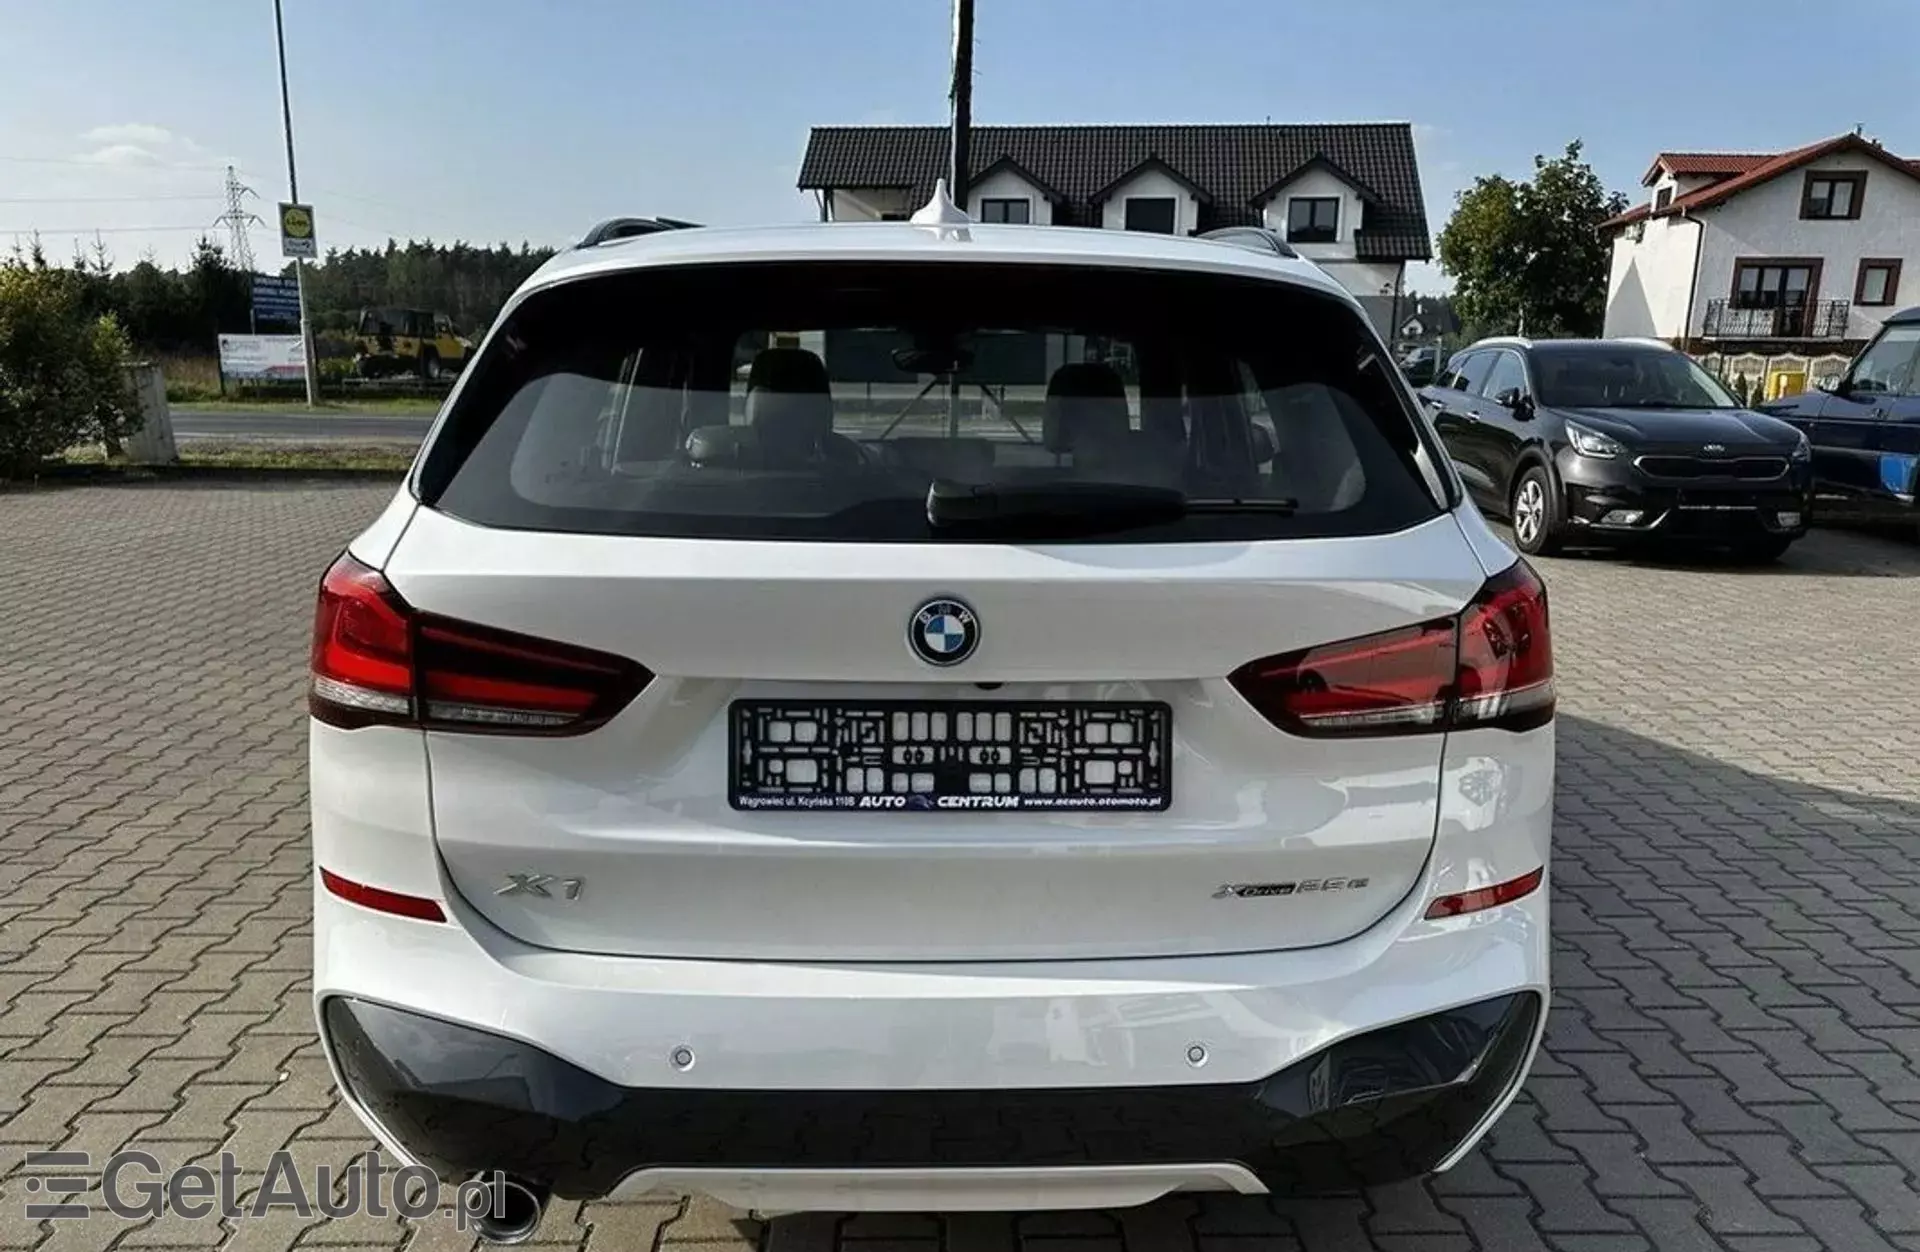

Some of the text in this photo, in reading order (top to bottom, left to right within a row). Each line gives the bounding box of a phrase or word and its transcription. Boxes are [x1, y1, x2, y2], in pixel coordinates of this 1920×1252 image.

[859, 796, 907, 808] AUTO
[937, 796, 1019, 808] CENTRUM
[492, 873, 584, 901] X1
